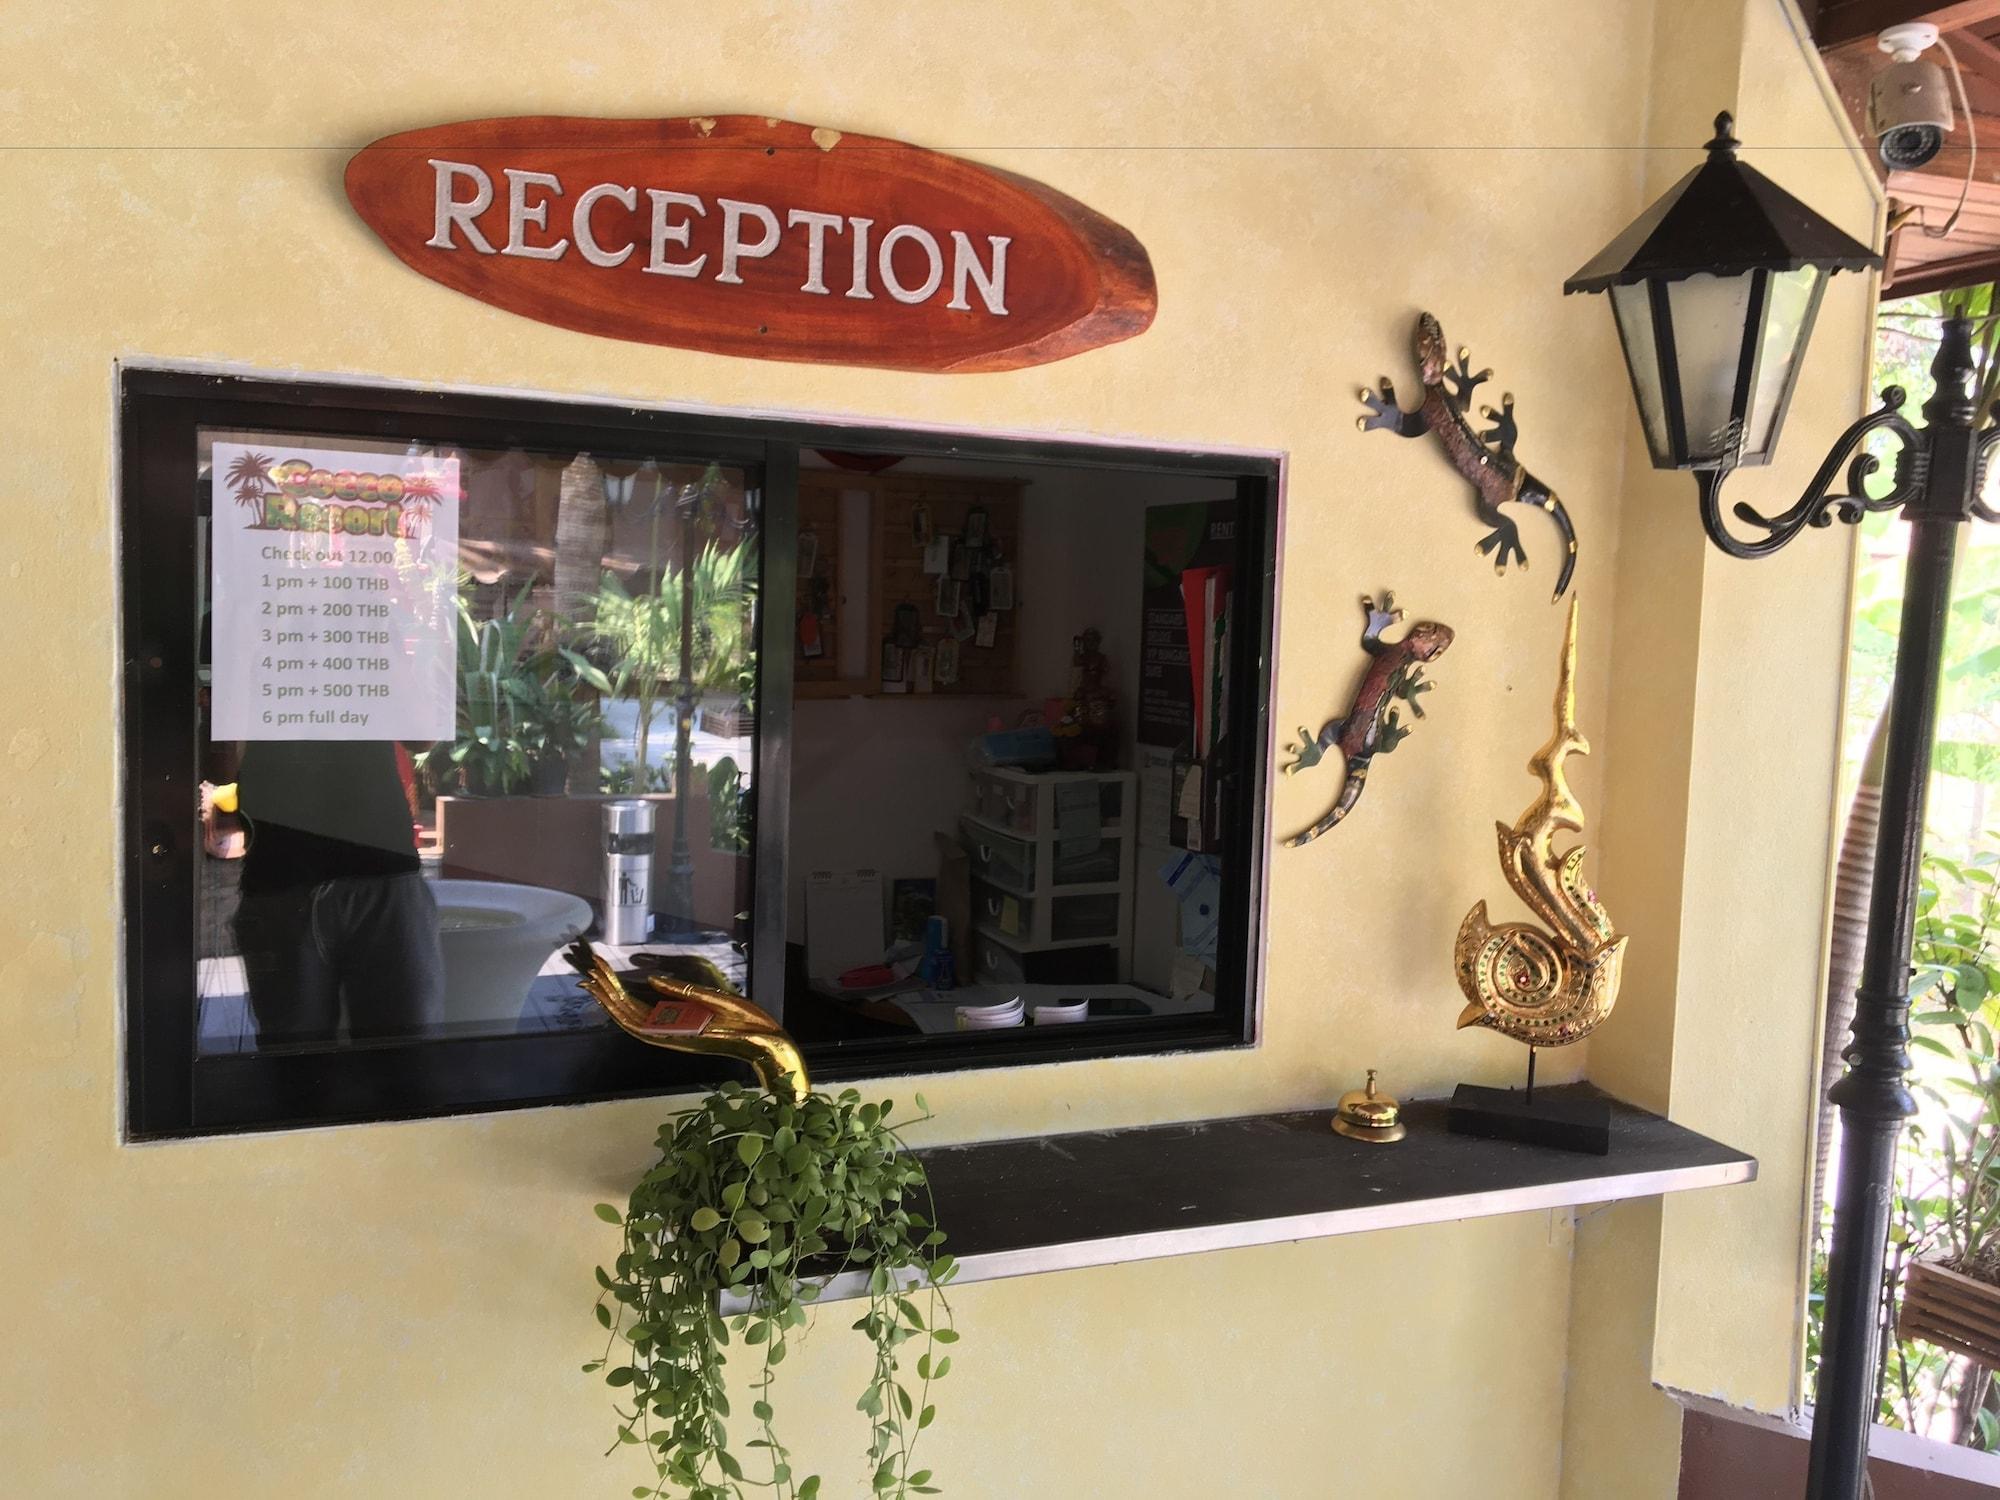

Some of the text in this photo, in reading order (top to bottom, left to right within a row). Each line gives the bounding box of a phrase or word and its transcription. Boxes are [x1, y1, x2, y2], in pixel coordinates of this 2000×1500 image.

[425, 158, 1011, 316] RECEPTION
[261, 546, 393, 564] Check out 12.00
[262, 575, 389, 591] 1 pm + 100 THB
[261, 602, 389, 618] 2 pm + 200 THB
[262, 629, 389, 645] 3 pm + 300 THB
[261, 657, 389, 672] 4 pm + 400 THB
[262, 683, 389, 699] 5 pm + 500 THB
[262, 710, 369, 726] 6 pm full day
